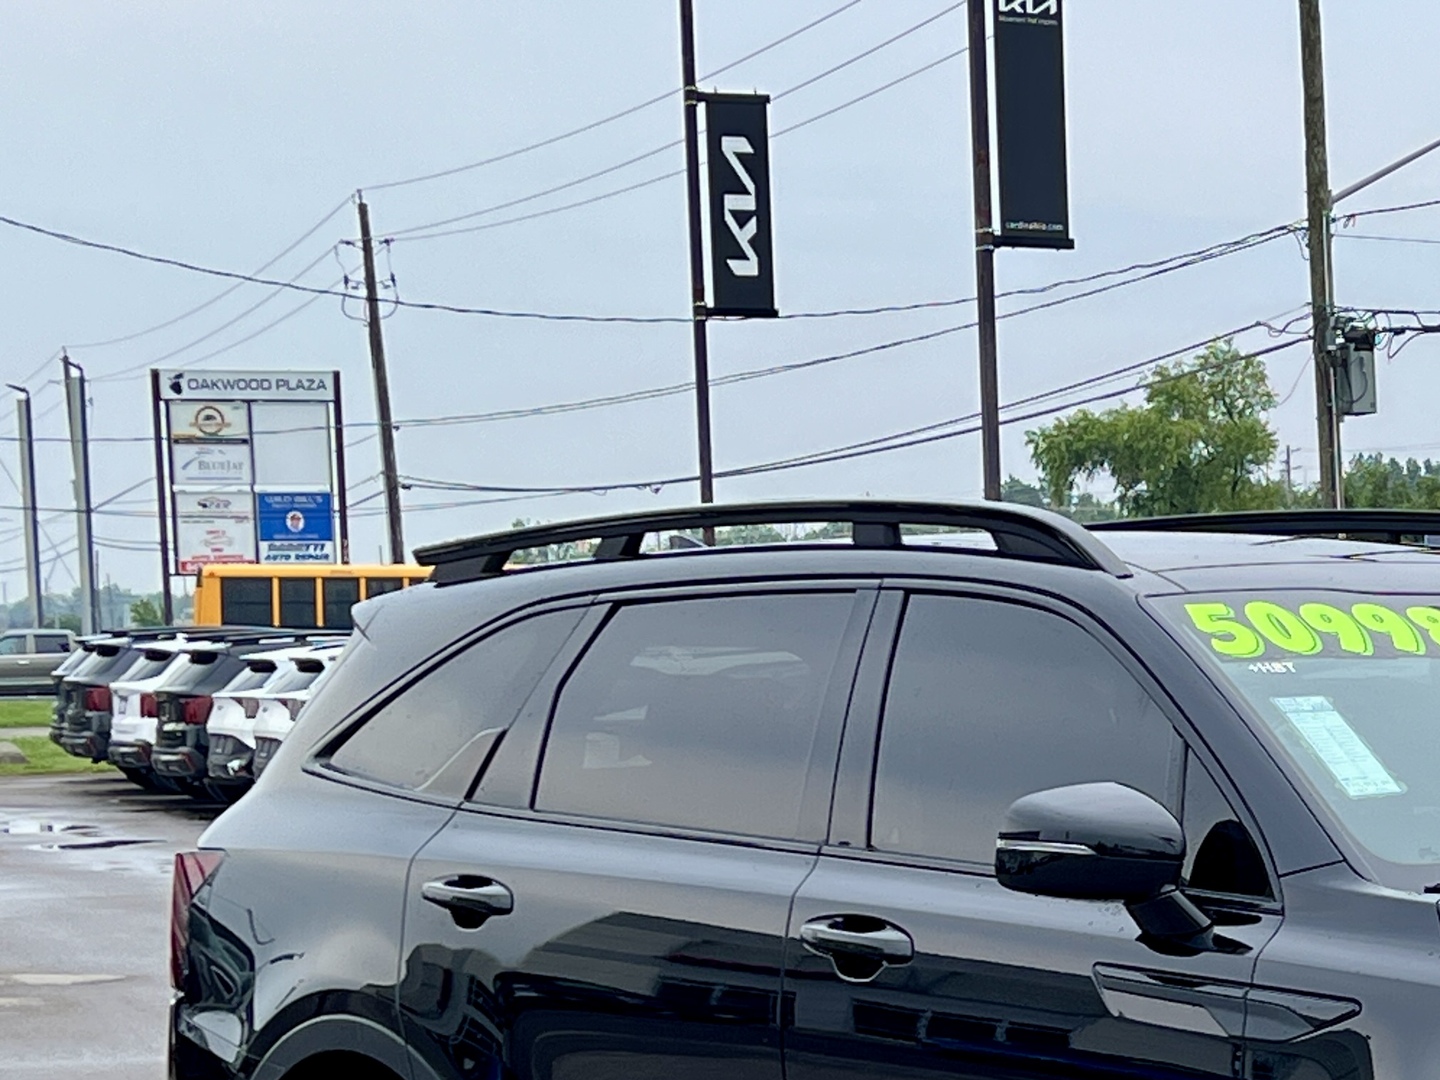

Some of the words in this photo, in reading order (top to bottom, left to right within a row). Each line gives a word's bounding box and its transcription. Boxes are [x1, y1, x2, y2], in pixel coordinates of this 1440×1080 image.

[998, 0, 1058, 15] KIA
[721, 136, 759, 276] KIA
[187, 378, 272, 391] OAKWOOD
[276, 378, 328, 391] PLAZA
